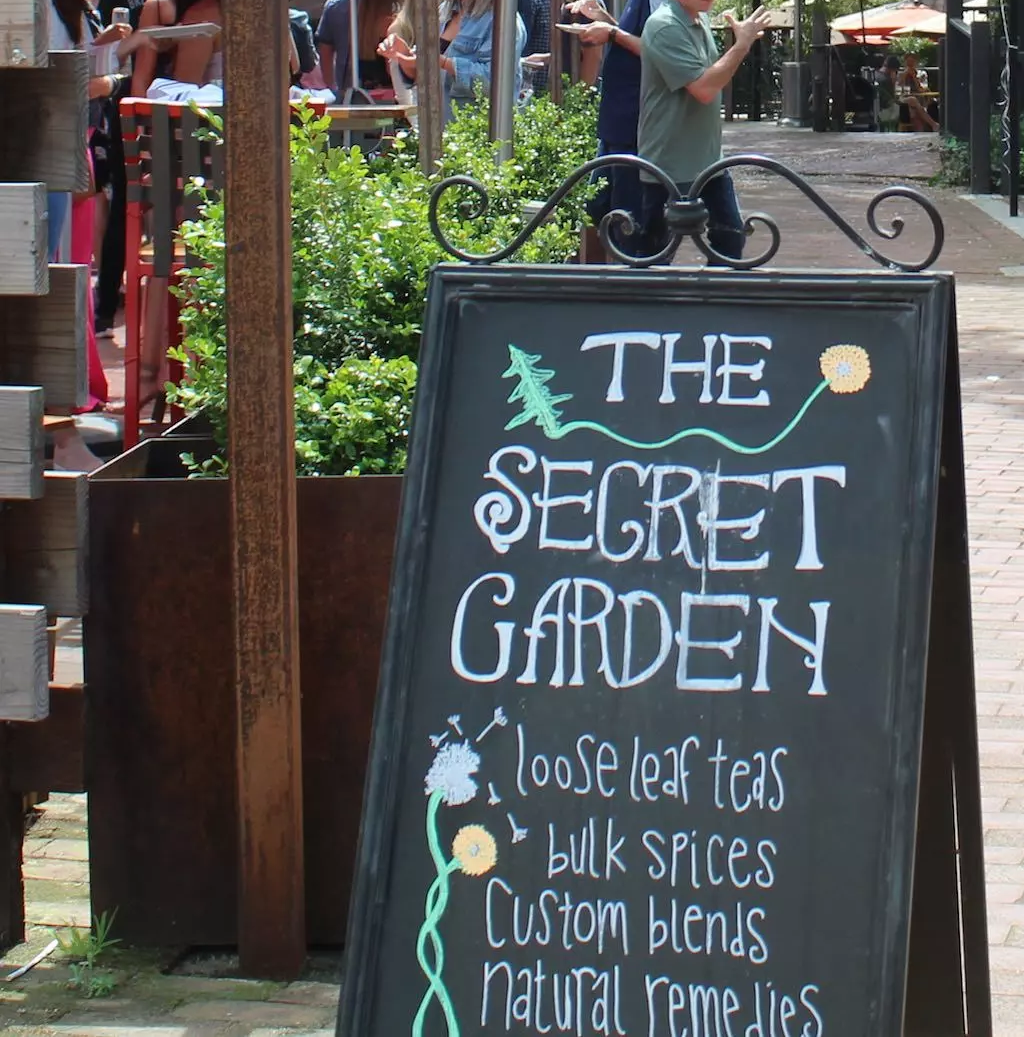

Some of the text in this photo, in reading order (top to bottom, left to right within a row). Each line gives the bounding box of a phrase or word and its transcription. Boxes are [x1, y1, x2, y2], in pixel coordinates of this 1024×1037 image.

[580, 331, 773, 406] THE
[473, 444, 846, 571] SECRET
[450, 572, 831, 696] GARDEN
[515, 723, 789, 812] loose leaf teas
[547, 817, 778, 889] bulk spices
[648, 894, 770, 964] blends
[480, 959, 824, 1037] natural remedies
